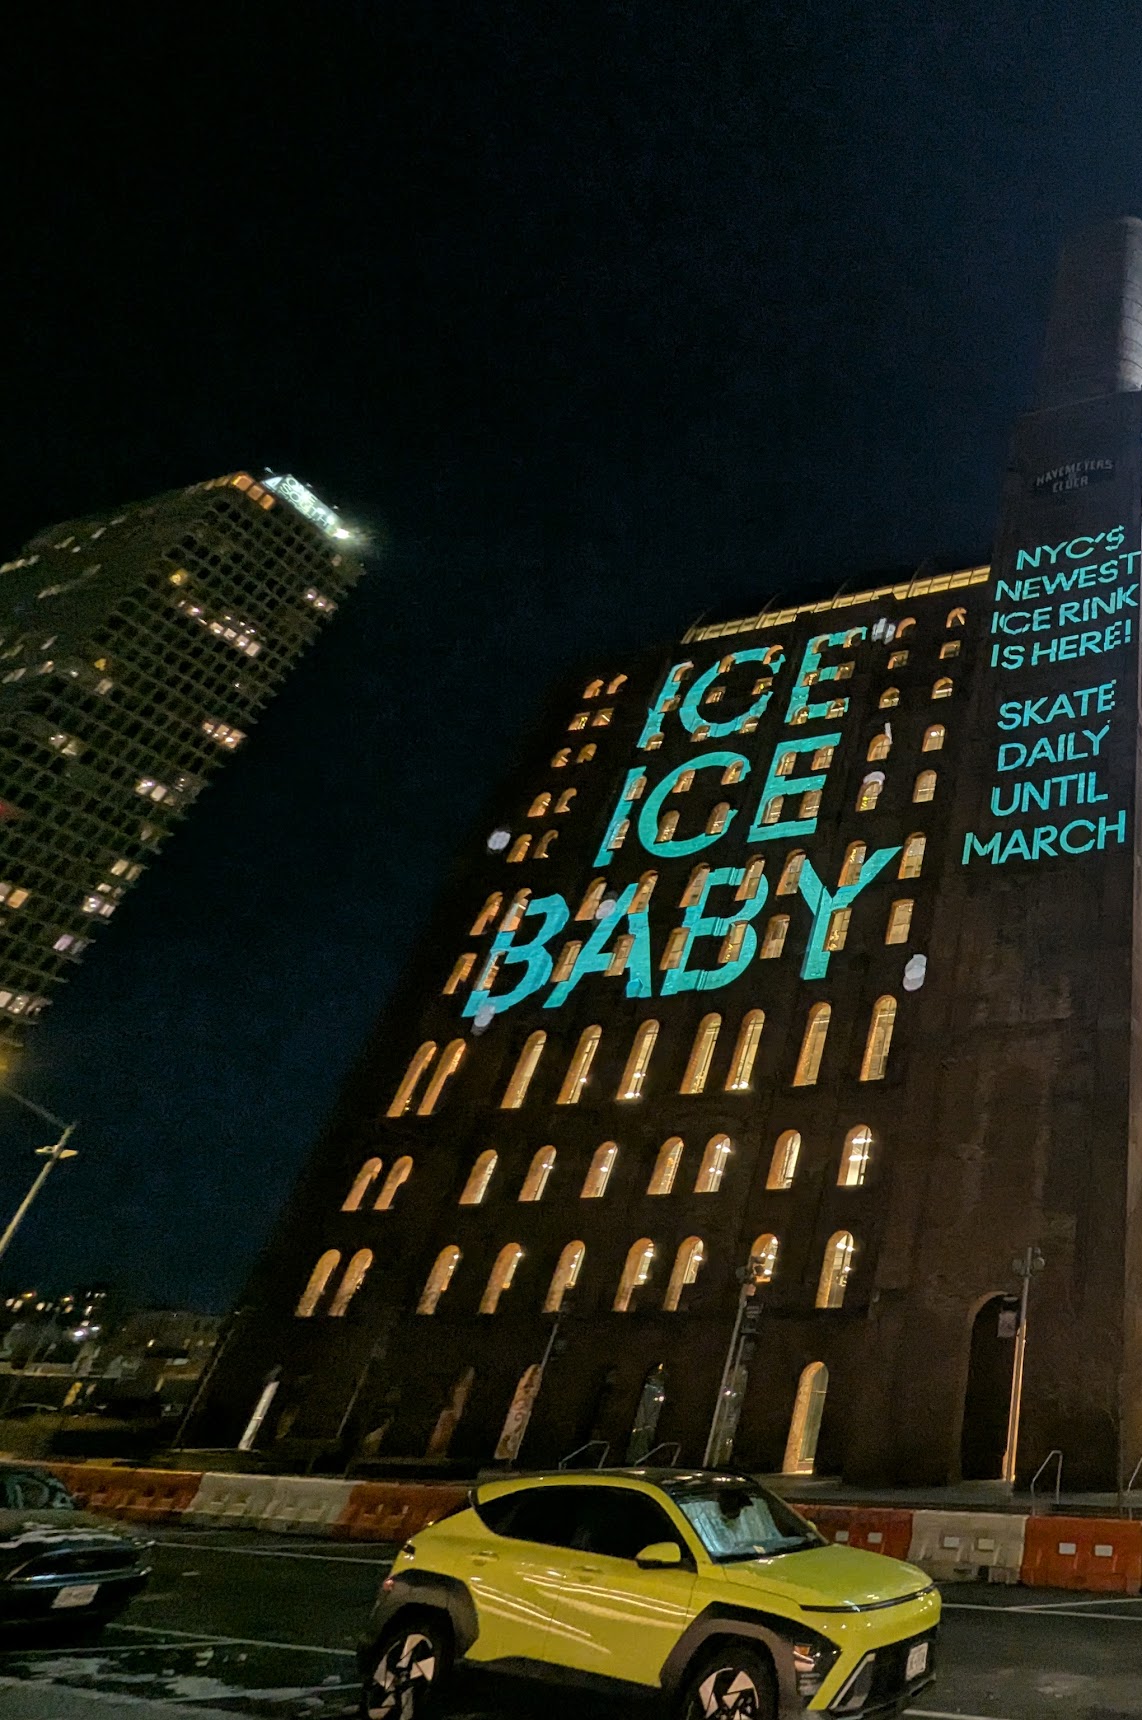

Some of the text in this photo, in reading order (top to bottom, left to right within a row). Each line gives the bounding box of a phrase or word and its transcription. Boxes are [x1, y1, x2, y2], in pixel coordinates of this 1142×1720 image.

[1015, 524, 1125, 571] NYC'S
[994, 550, 1142, 602] NEWEST
[990, 583, 1139, 635] ICE RINK
[990, 618, 1132, 670] IS HERE!
[636, 626, 867, 749] ICE
[997, 679, 1117, 731] SKATE
[996, 719, 1111, 772] DAILY
[593, 732, 842, 867] ICE
[990, 771, 1109, 817] UNTIL
[961, 809, 1127, 865] MARCH
[461, 846, 903, 1018] BABY
